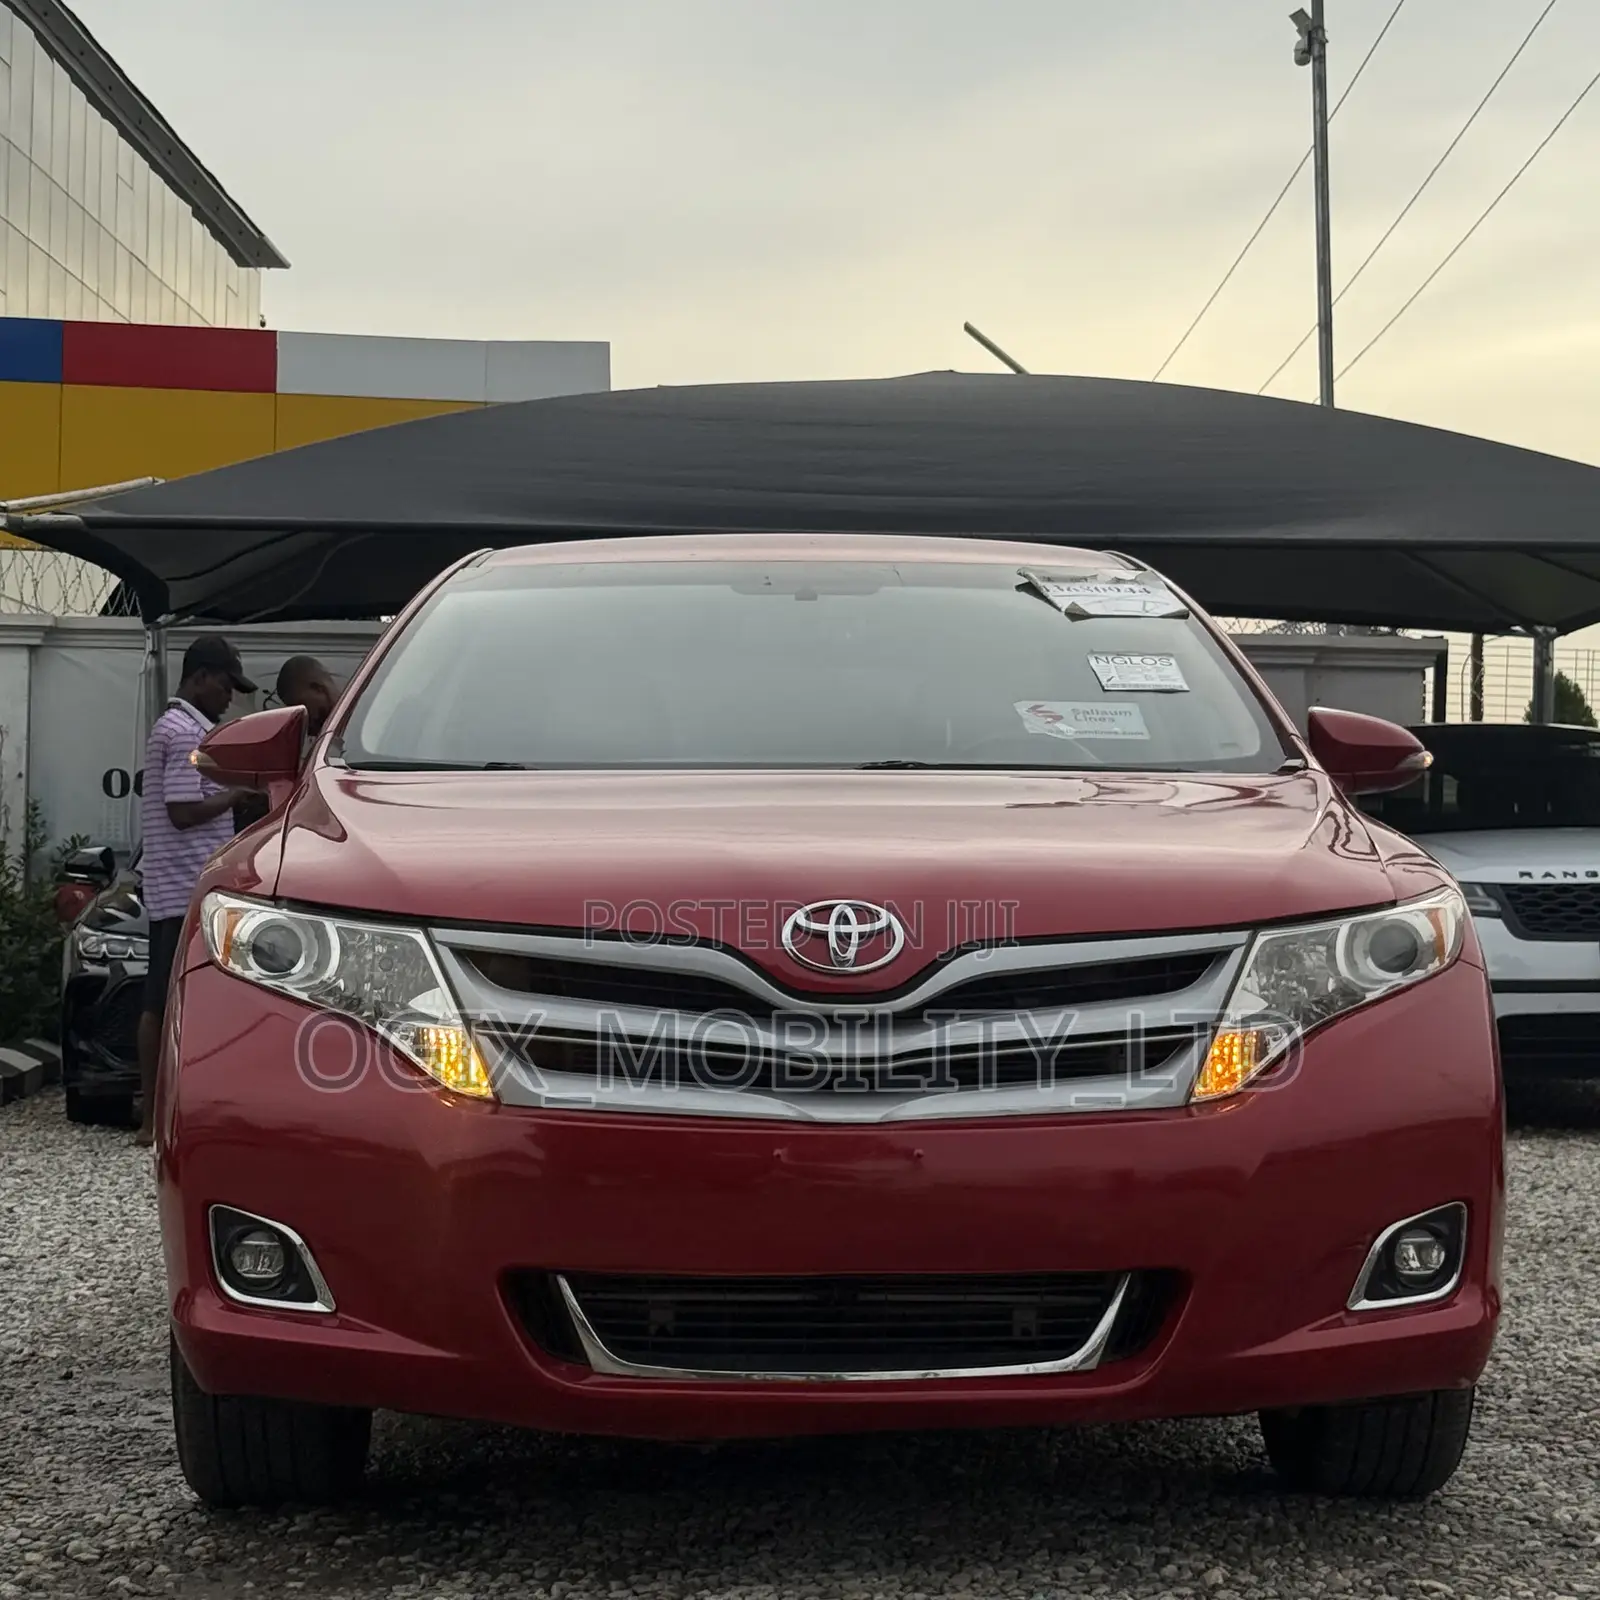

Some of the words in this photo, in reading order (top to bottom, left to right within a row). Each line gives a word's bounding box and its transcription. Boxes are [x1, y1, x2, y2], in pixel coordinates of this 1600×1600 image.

[1094, 656, 1173, 667] NGLOS
[1074, 713, 1116, 723] Lines
[1518, 870, 1599, 880] RANG
